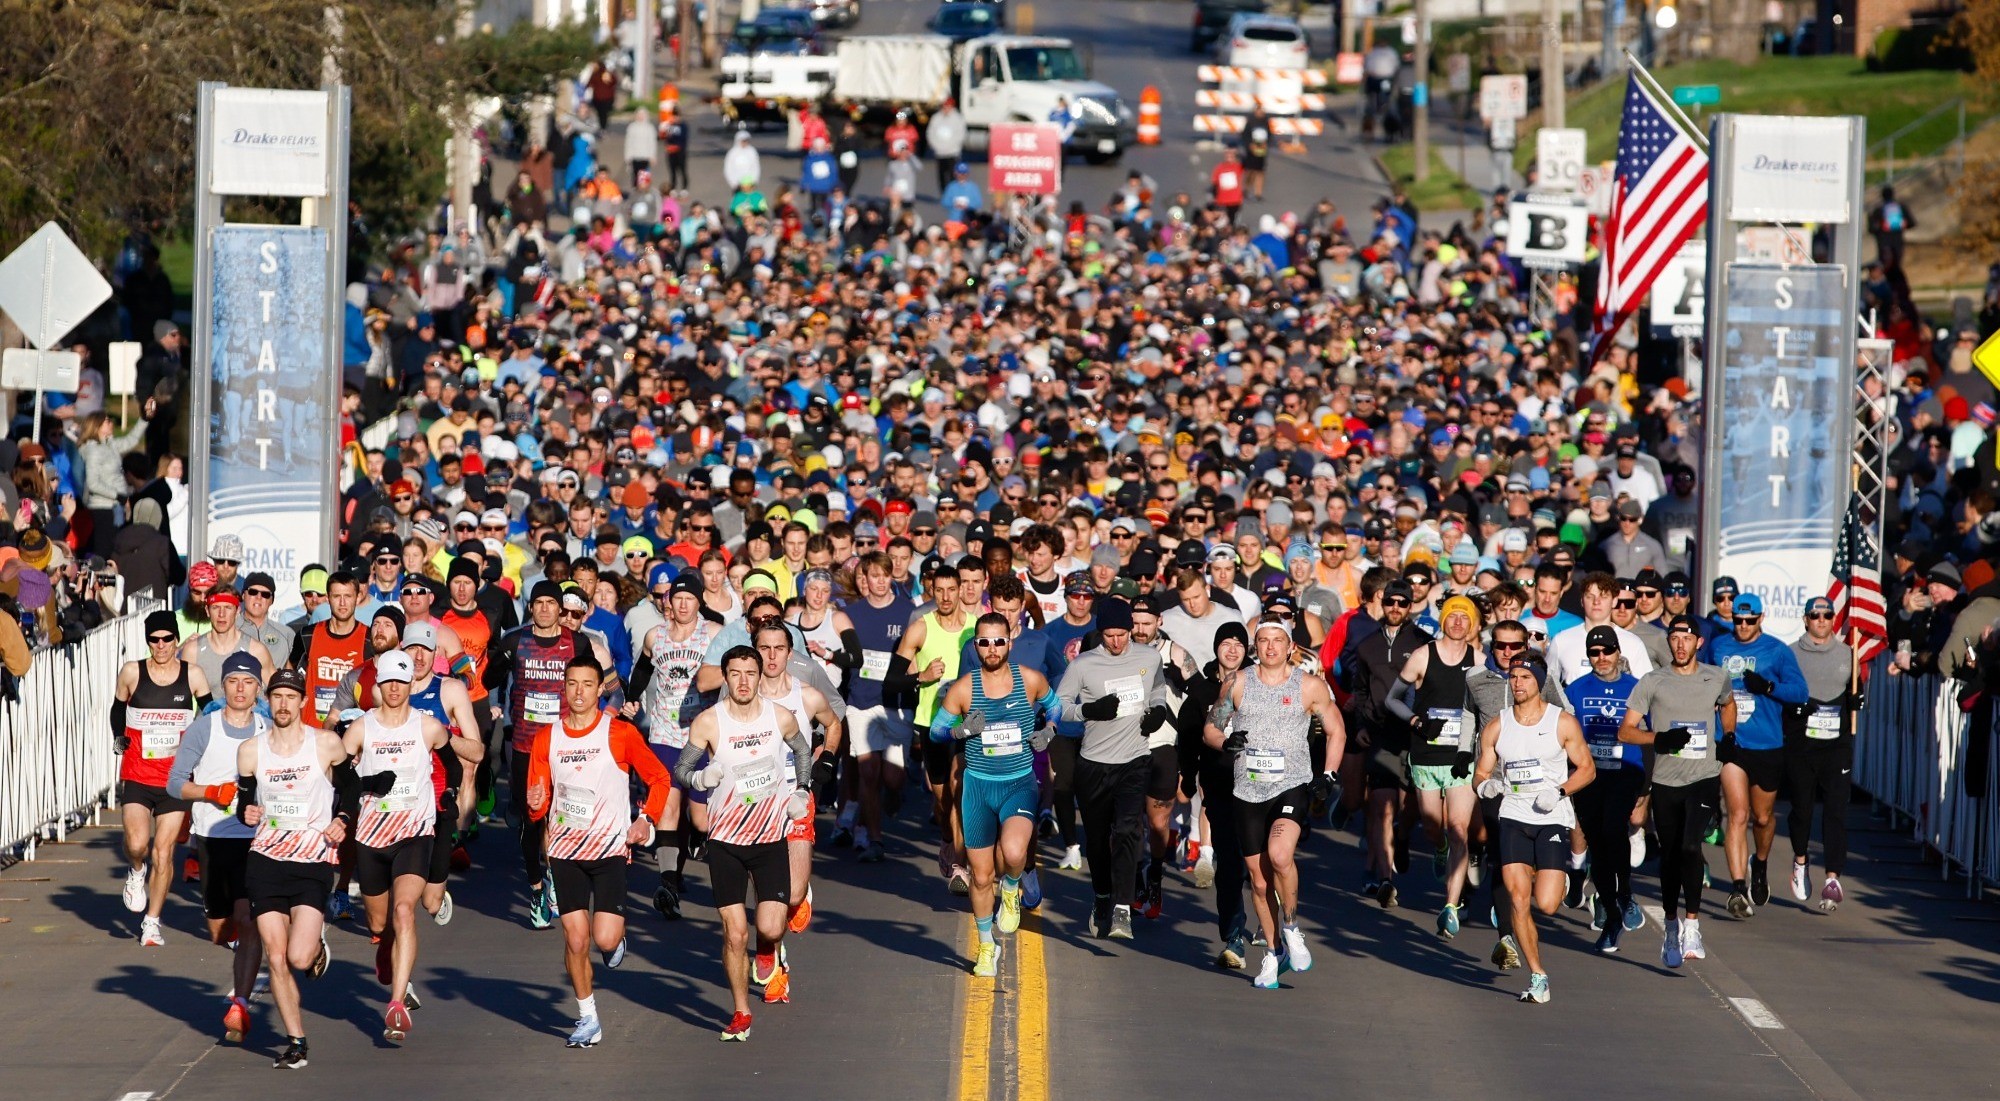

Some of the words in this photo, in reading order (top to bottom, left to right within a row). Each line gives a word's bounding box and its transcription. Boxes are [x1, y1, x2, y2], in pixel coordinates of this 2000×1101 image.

[232, 127, 278, 144] Drake
[279, 135, 317, 145] RELAYS
[1753, 154, 1799, 171] Drake
[1003, 171, 1043, 187] AREA
[1525, 213, 1567, 250] B
[255, 241, 278, 471] START
[1768, 277, 1793, 507] START
[245, 548, 295, 569] RAKE
[525, 659, 545, 669] MILL
[546, 660, 565, 669] CITY
[525, 670, 565, 680] RUNNING
[1117, 692, 1139, 702] 0035
[534, 702, 549, 710] 828
[140, 712, 185, 720] FITNESS
[149, 737, 175, 745] 10430
[728, 730, 773, 743] RUNABLAZE
[994, 733, 1010, 741] 904
[733, 739, 761, 749] IOWA
[376, 747, 403, 755] IOWA
[557, 748, 601, 757] RUNABLAZE
[1597, 748, 1613, 756] 895
[560, 755, 587, 763] IOWA
[1256, 760, 1273, 768] 885
[265, 765, 310, 776] RUNABLAZE
[1516, 770, 1531, 778] 773
[269, 773, 297, 782] IOWA
[745, 774, 771, 789] 10704
[387, 786, 410, 795] 646
[273, 805, 300, 814] 10461
[562, 802, 587, 816] 10659
